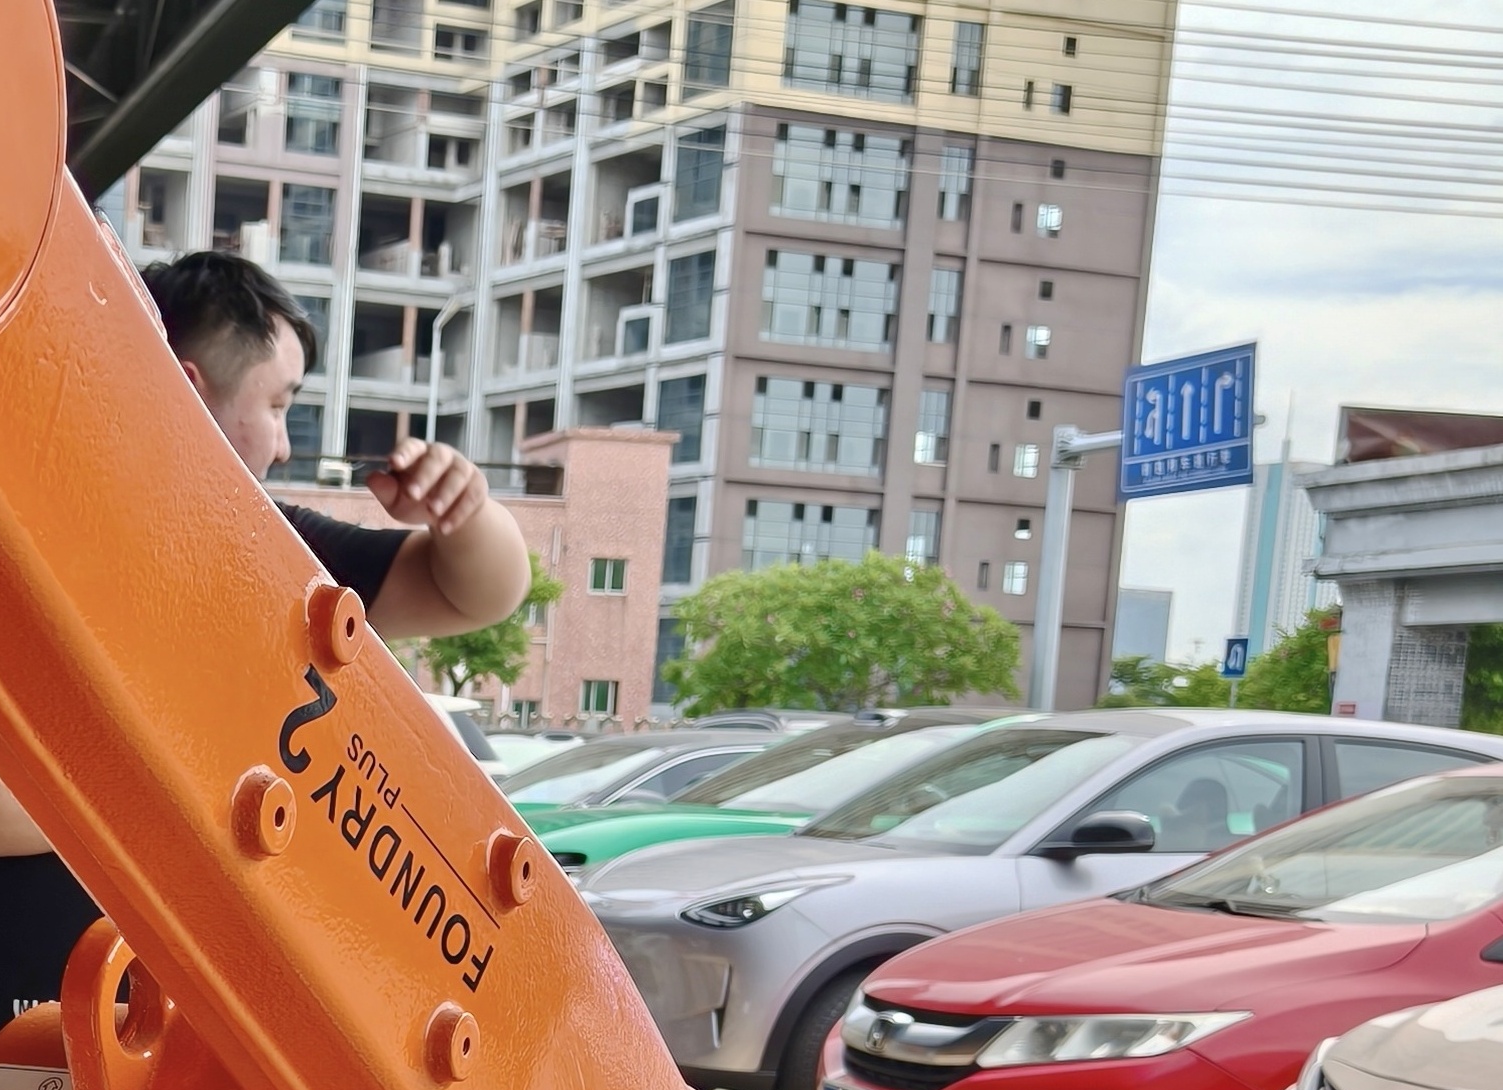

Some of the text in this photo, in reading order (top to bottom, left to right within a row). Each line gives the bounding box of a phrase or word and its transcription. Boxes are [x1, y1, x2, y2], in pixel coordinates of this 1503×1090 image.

[279, 663, 494, 993] FOUNDRY 2
[347, 733, 401, 809] PLUS
